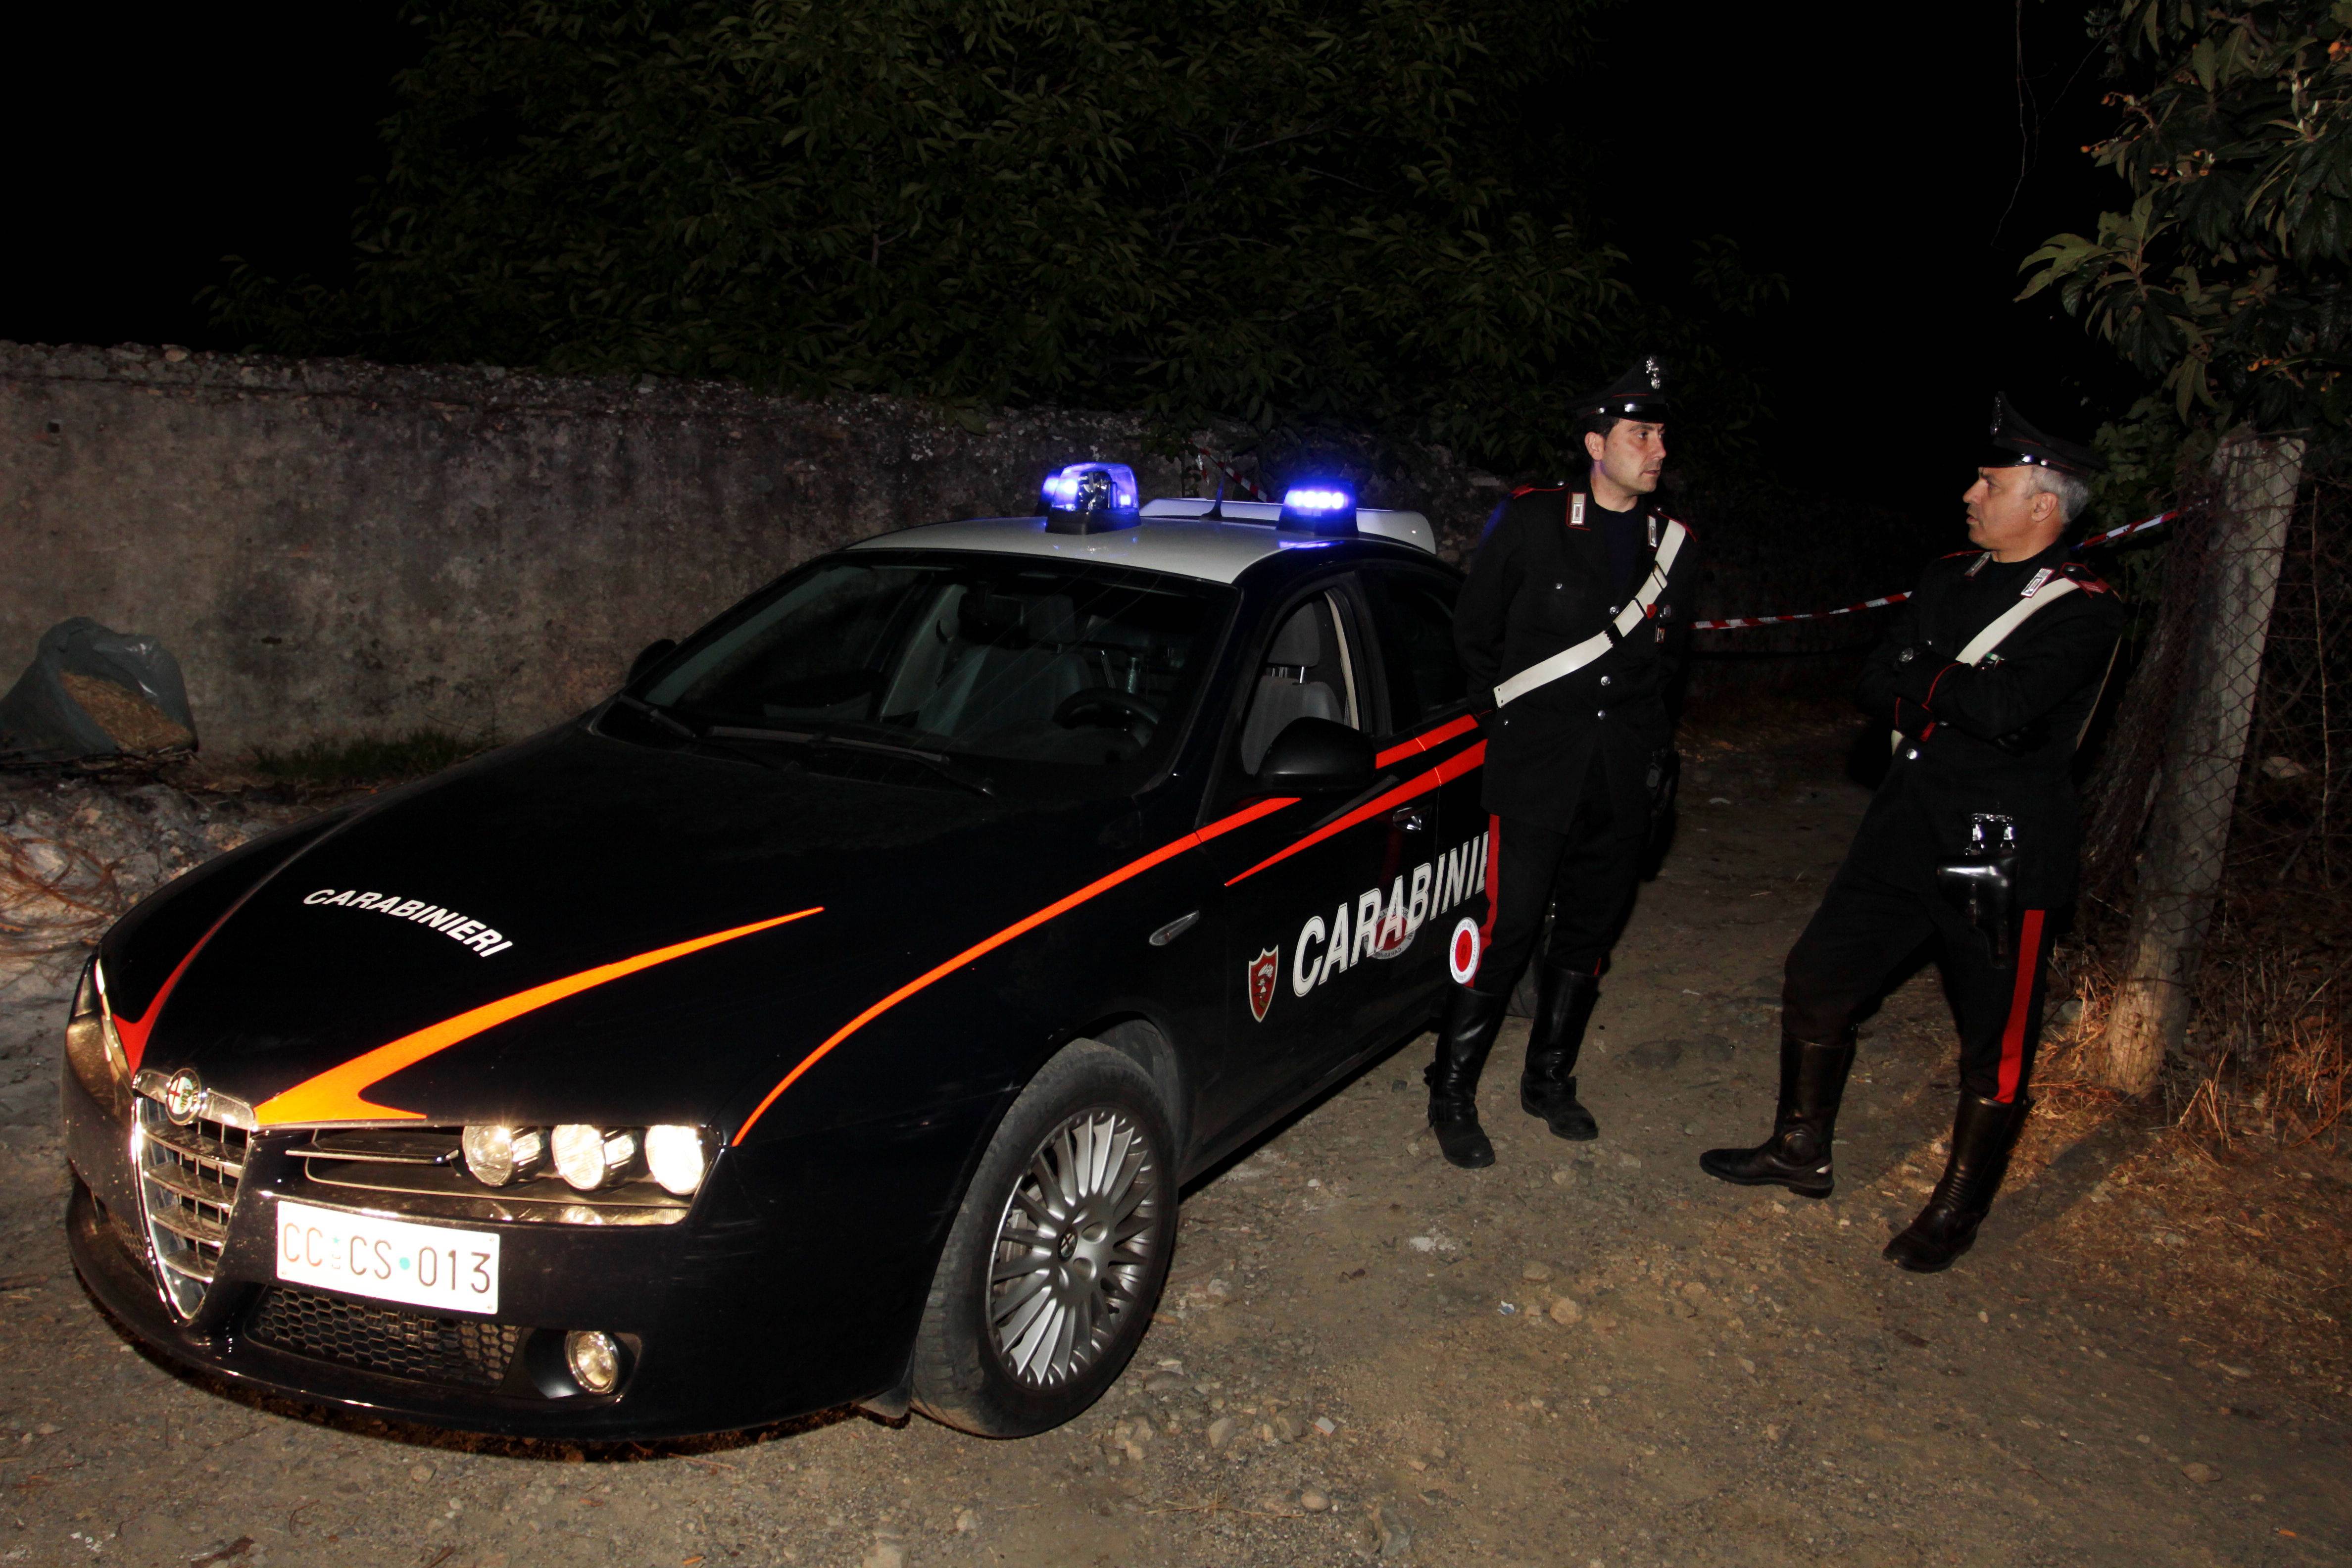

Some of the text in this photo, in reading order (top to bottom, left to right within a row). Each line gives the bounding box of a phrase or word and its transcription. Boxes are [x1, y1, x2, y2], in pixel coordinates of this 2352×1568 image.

[303, 889, 513, 957] CARABINIERI
[1451, 921, 1467, 952] MINISTERO
[284, 1223, 491, 1294] CC CS 013
